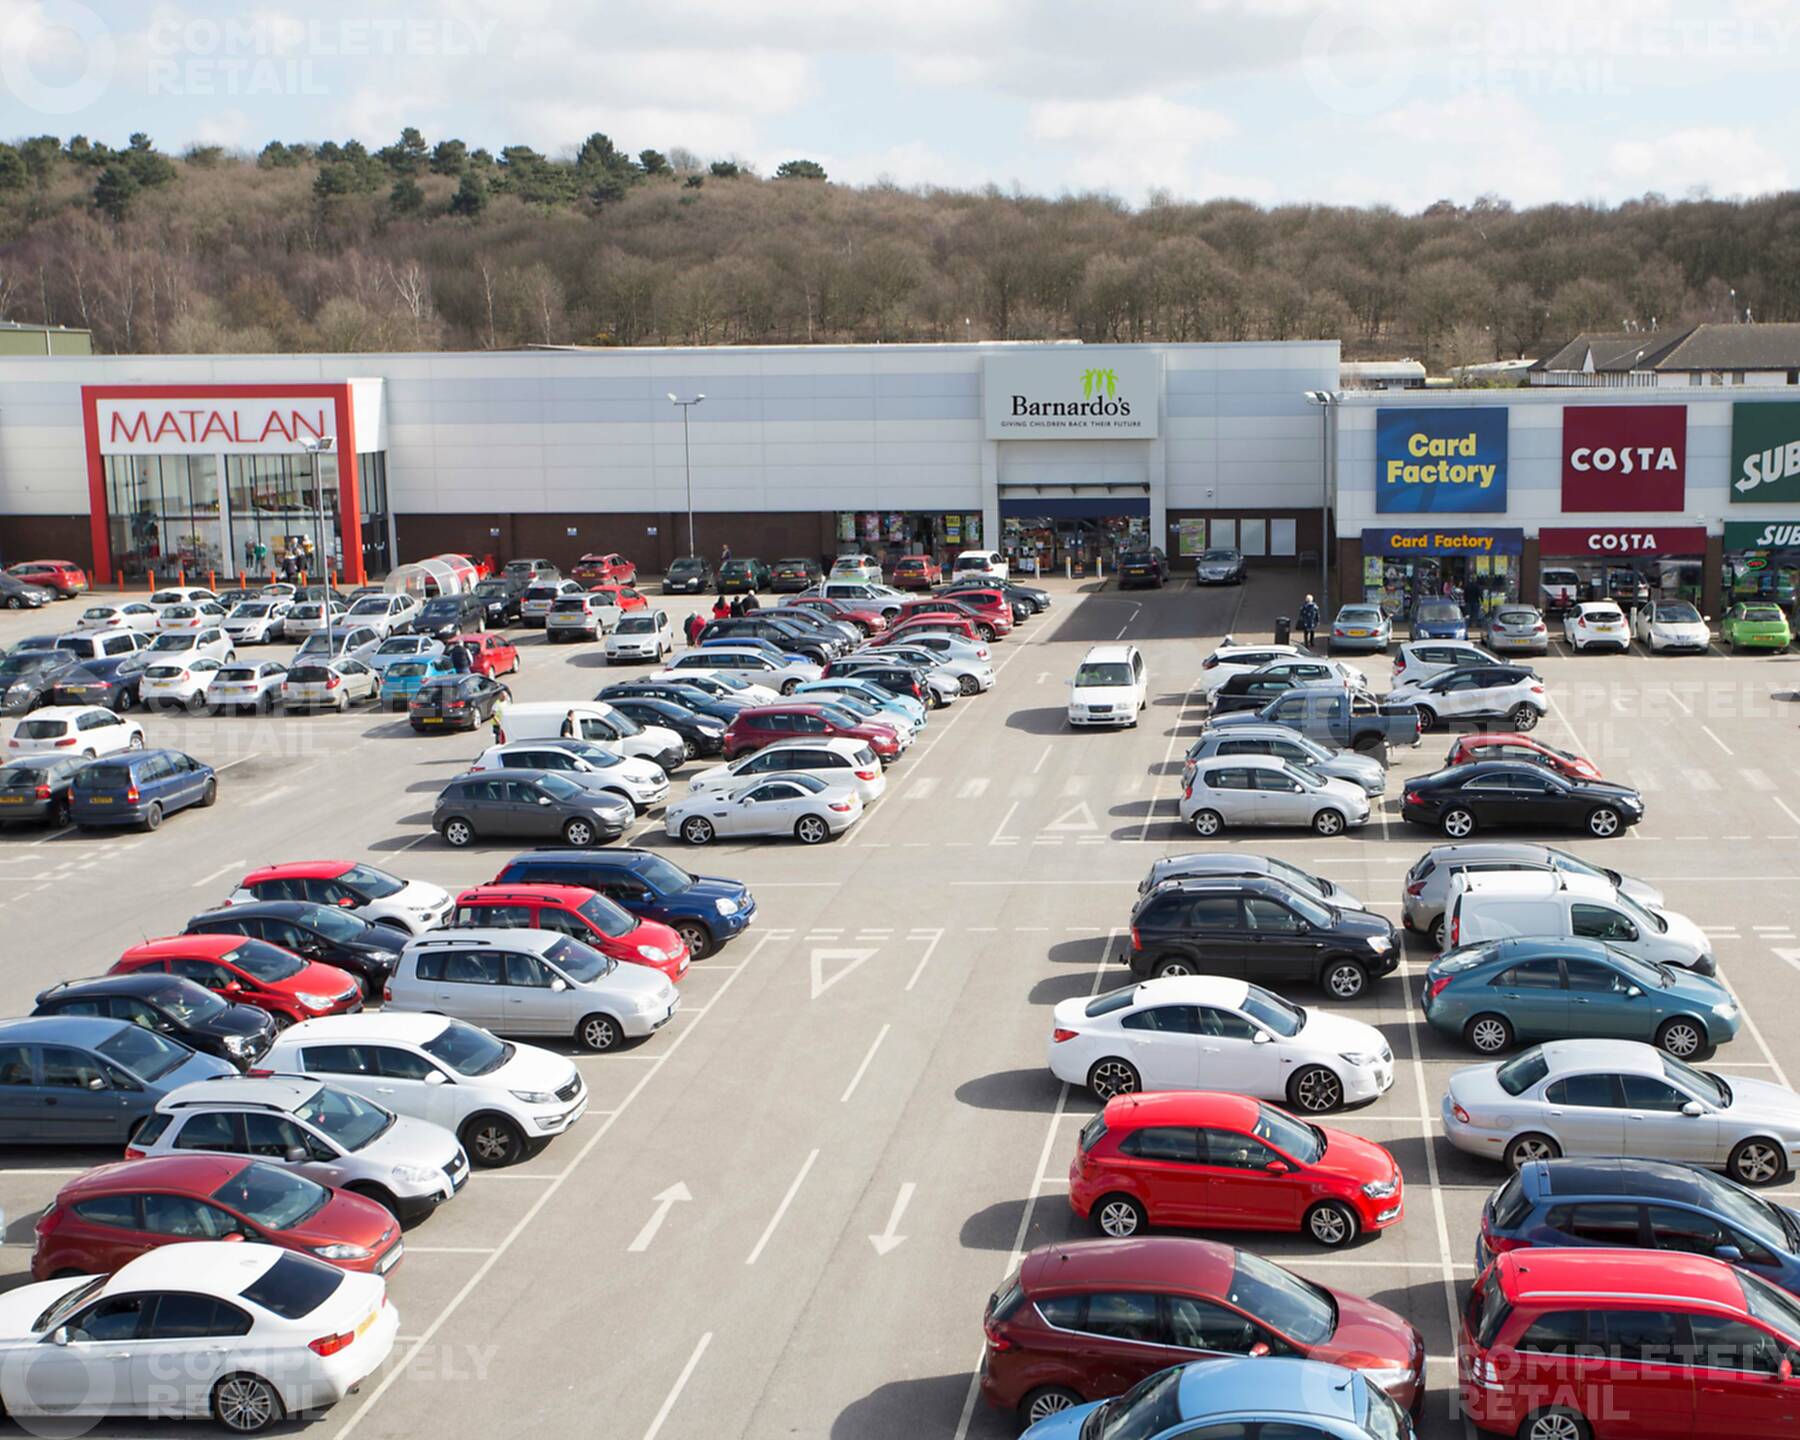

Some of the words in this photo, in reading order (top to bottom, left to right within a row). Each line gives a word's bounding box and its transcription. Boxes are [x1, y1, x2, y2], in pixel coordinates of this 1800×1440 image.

[1010, 394, 1131, 416] Barnardo's
[110, 409, 325, 443] MATALAN
[1000, 420, 1027, 428] GIVING
[1029, 420, 1066, 428] CHILDREN
[1068, 420, 1088, 428] BACK
[1091, 420, 1111, 428] THEIR
[1113, 420, 1142, 428] FUTURE
[1408, 433, 1476, 457] Card
[1571, 446, 1678, 475] COSTA
[1387, 460, 1496, 488] Factory
[1391, 534, 1428, 549] Card
[1434, 534, 1494, 550] Factory
[1587, 533, 1658, 552] COSTA
